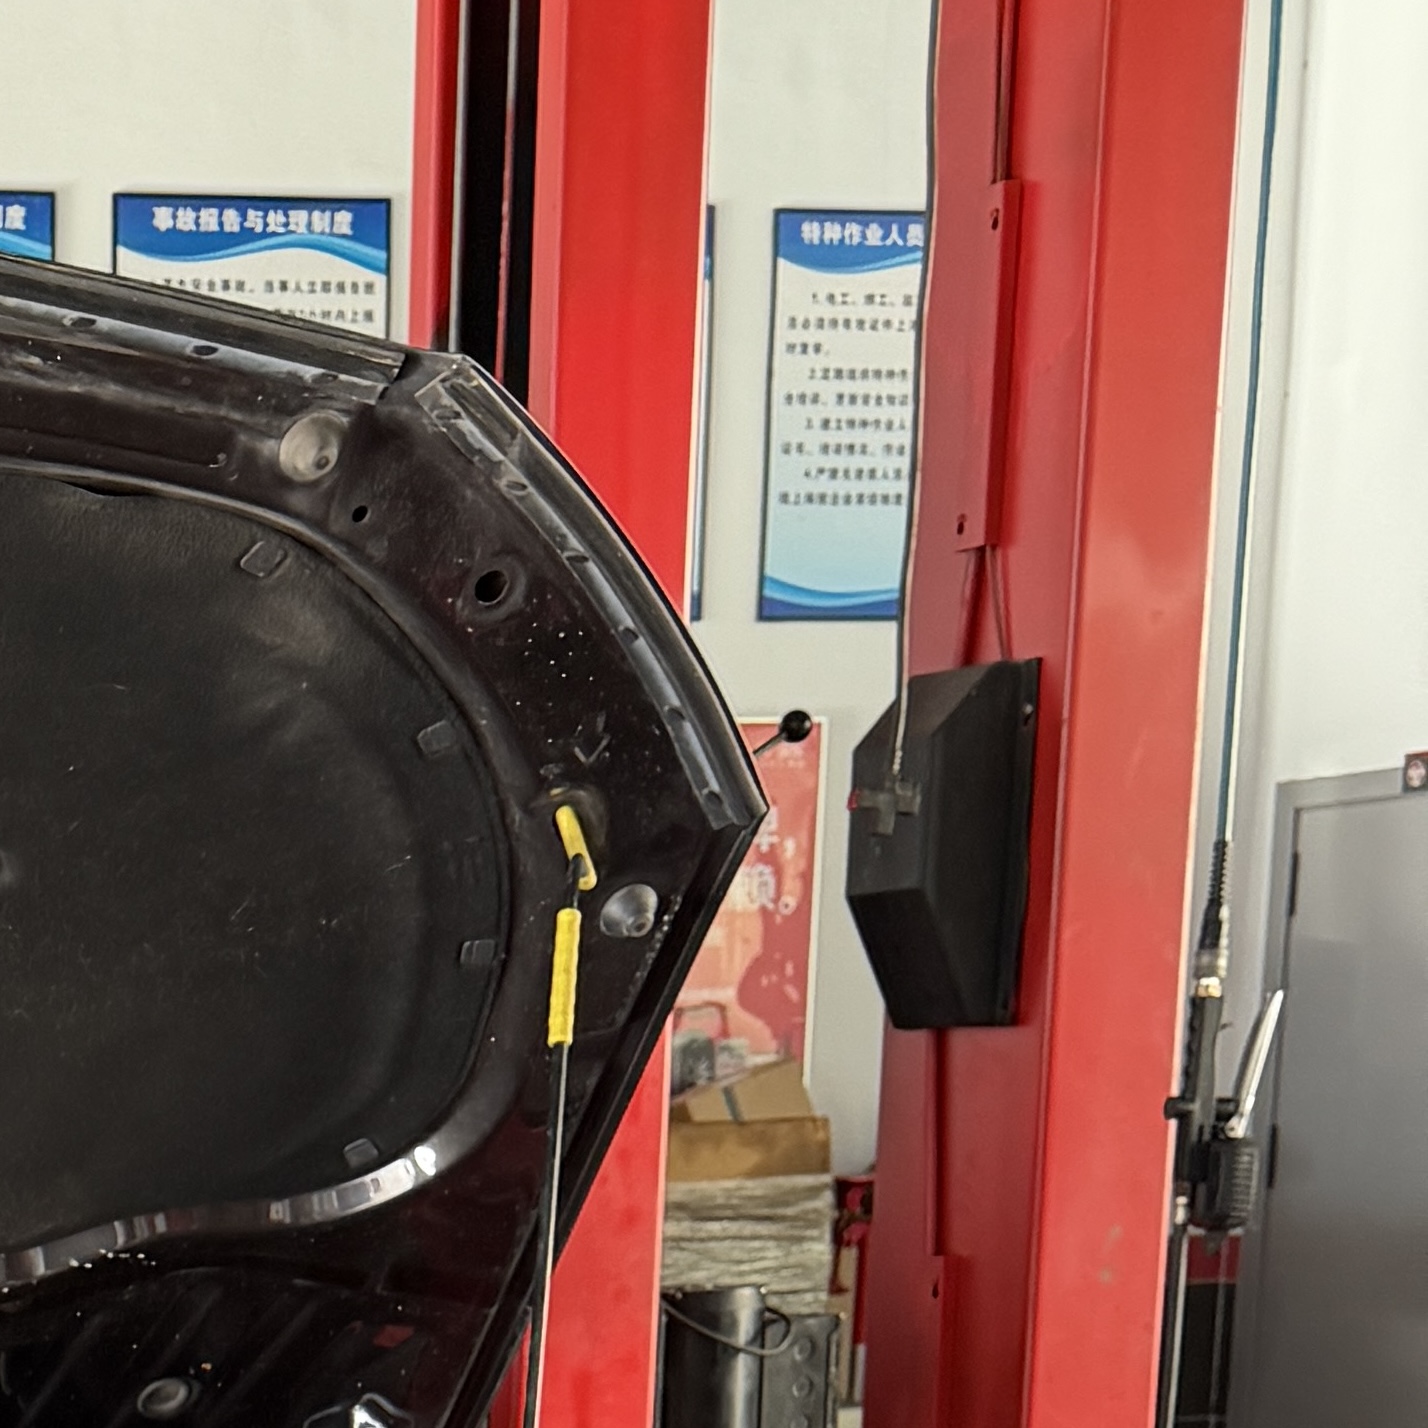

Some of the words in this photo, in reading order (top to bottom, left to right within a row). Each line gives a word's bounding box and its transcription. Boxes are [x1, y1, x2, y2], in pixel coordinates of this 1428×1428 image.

[152, 206, 354, 235] 事故报告与处理制度
